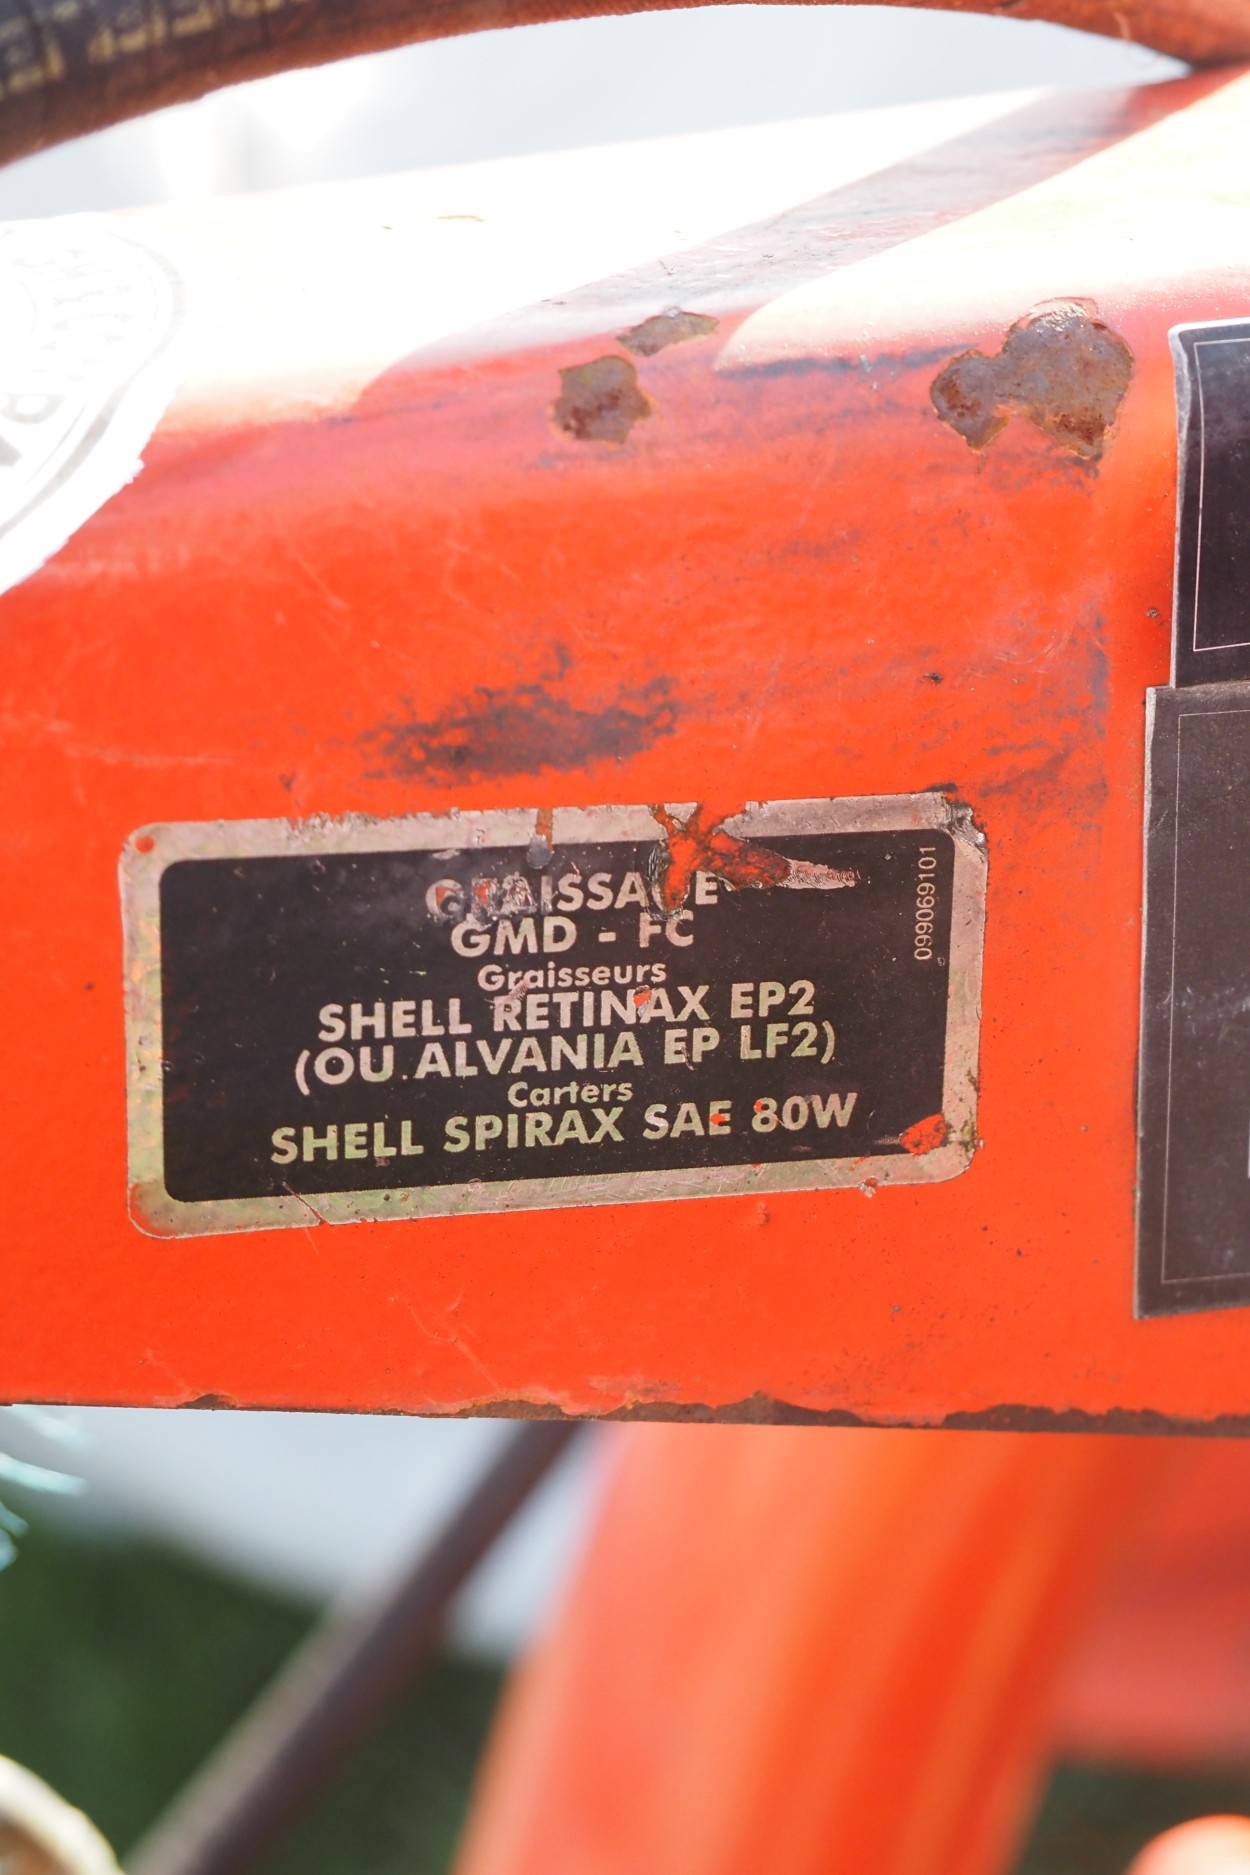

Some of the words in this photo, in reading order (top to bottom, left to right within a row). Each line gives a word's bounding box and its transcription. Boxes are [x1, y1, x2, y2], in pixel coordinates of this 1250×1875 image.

[913, 845, 938, 961] 099069101
[450, 916, 578, 957] GMD
[477, 961, 667, 993] Graisseurs
[317, 998, 473, 1042] SHELL
[491, 985, 709, 1031] RETINAX
[730, 979, 816, 1020] EP2
[294, 1045, 396, 1096] (OU
[415, 1032, 645, 1079] ALVANIA
[663, 1029, 721, 1066] EP
[740, 1020, 836, 1065] LF2)
[507, 1080, 633, 1108] Carters
[270, 1119, 424, 1165] SHELL
[443, 1106, 624, 1154] SPIRAX
[641, 1099, 731, 1140] SAE
[750, 1092, 858, 1134] 80W
